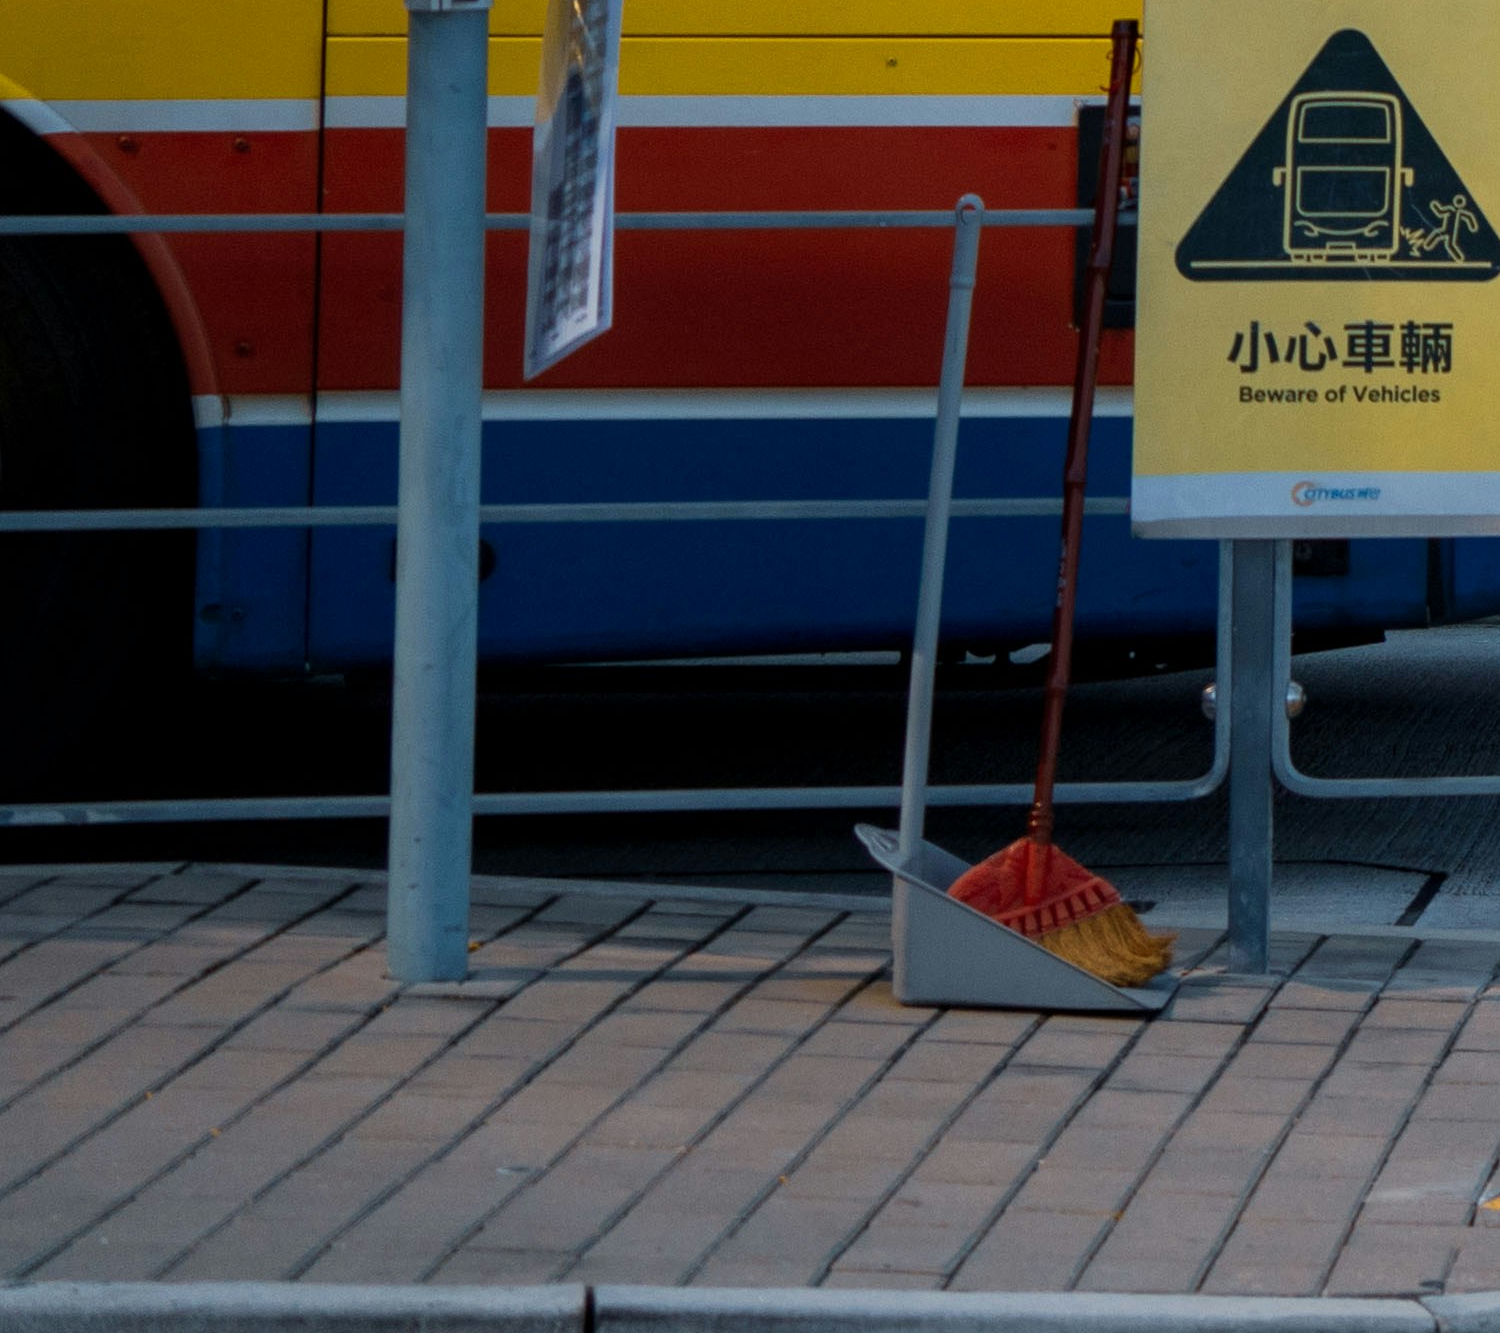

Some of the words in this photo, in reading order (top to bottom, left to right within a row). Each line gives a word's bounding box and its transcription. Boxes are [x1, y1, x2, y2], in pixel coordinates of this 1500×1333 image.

[1227, 320, 1453, 374] 小心車輛
[1239, 386, 1318, 403] Beware
[1324, 386, 1346, 403] of
[1353, 386, 1440, 403] Vehicles
